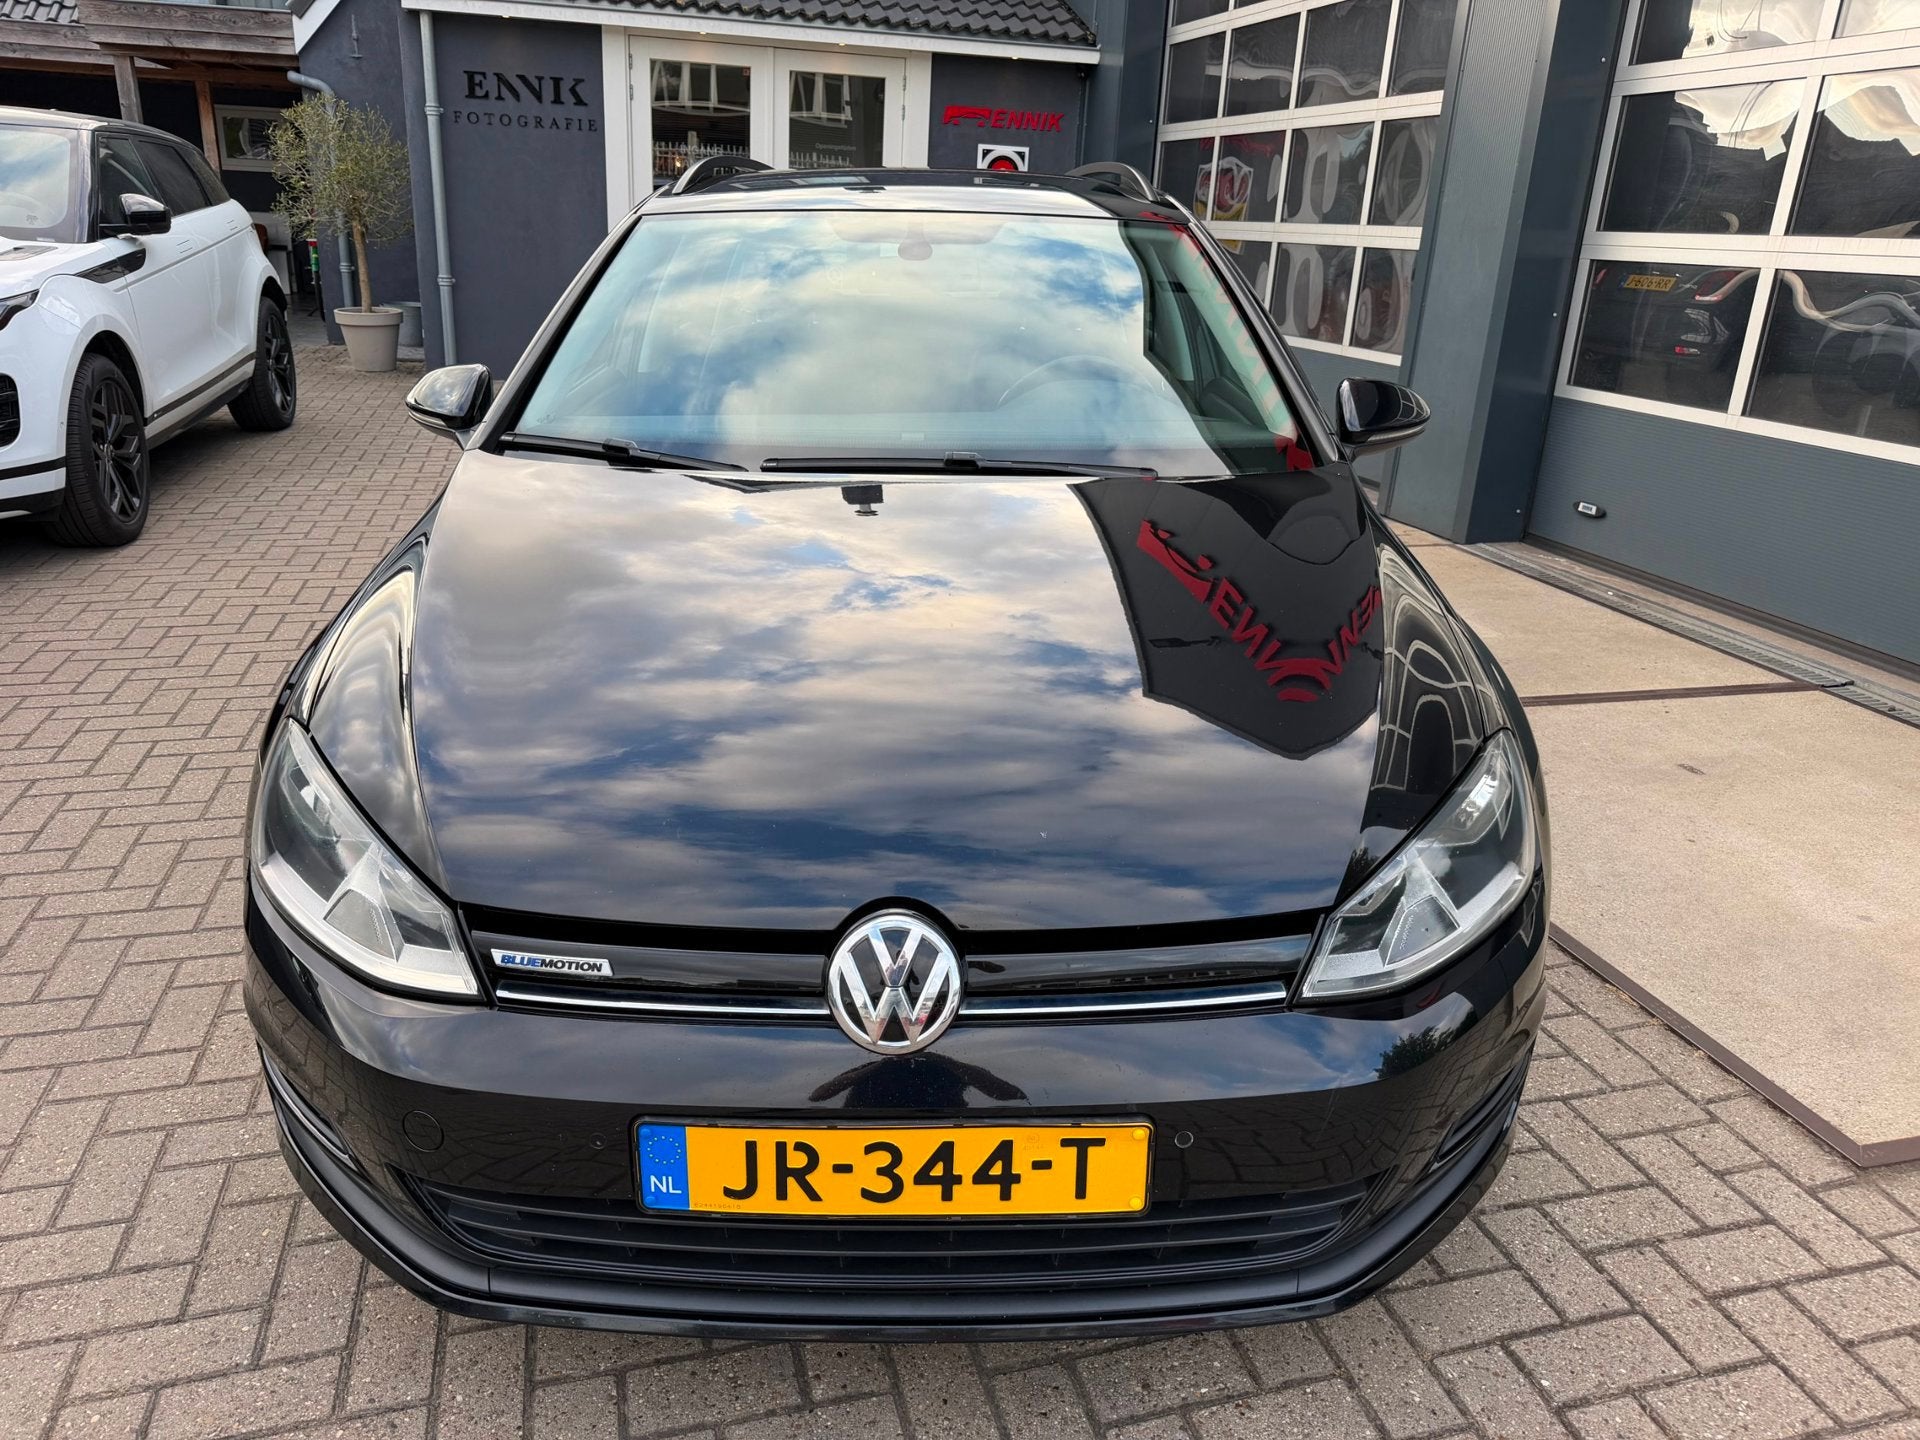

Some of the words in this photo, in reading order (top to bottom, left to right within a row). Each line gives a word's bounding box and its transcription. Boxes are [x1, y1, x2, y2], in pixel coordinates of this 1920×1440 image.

[453, 110, 598, 132] FOTOGRAFIE
[500, 954, 603, 973] BLUEMOTION
[836, 926, 954, 1046] VW
[722, 1137, 1107, 1203] JR-344-T
[650, 1174, 682, 1194] NL
